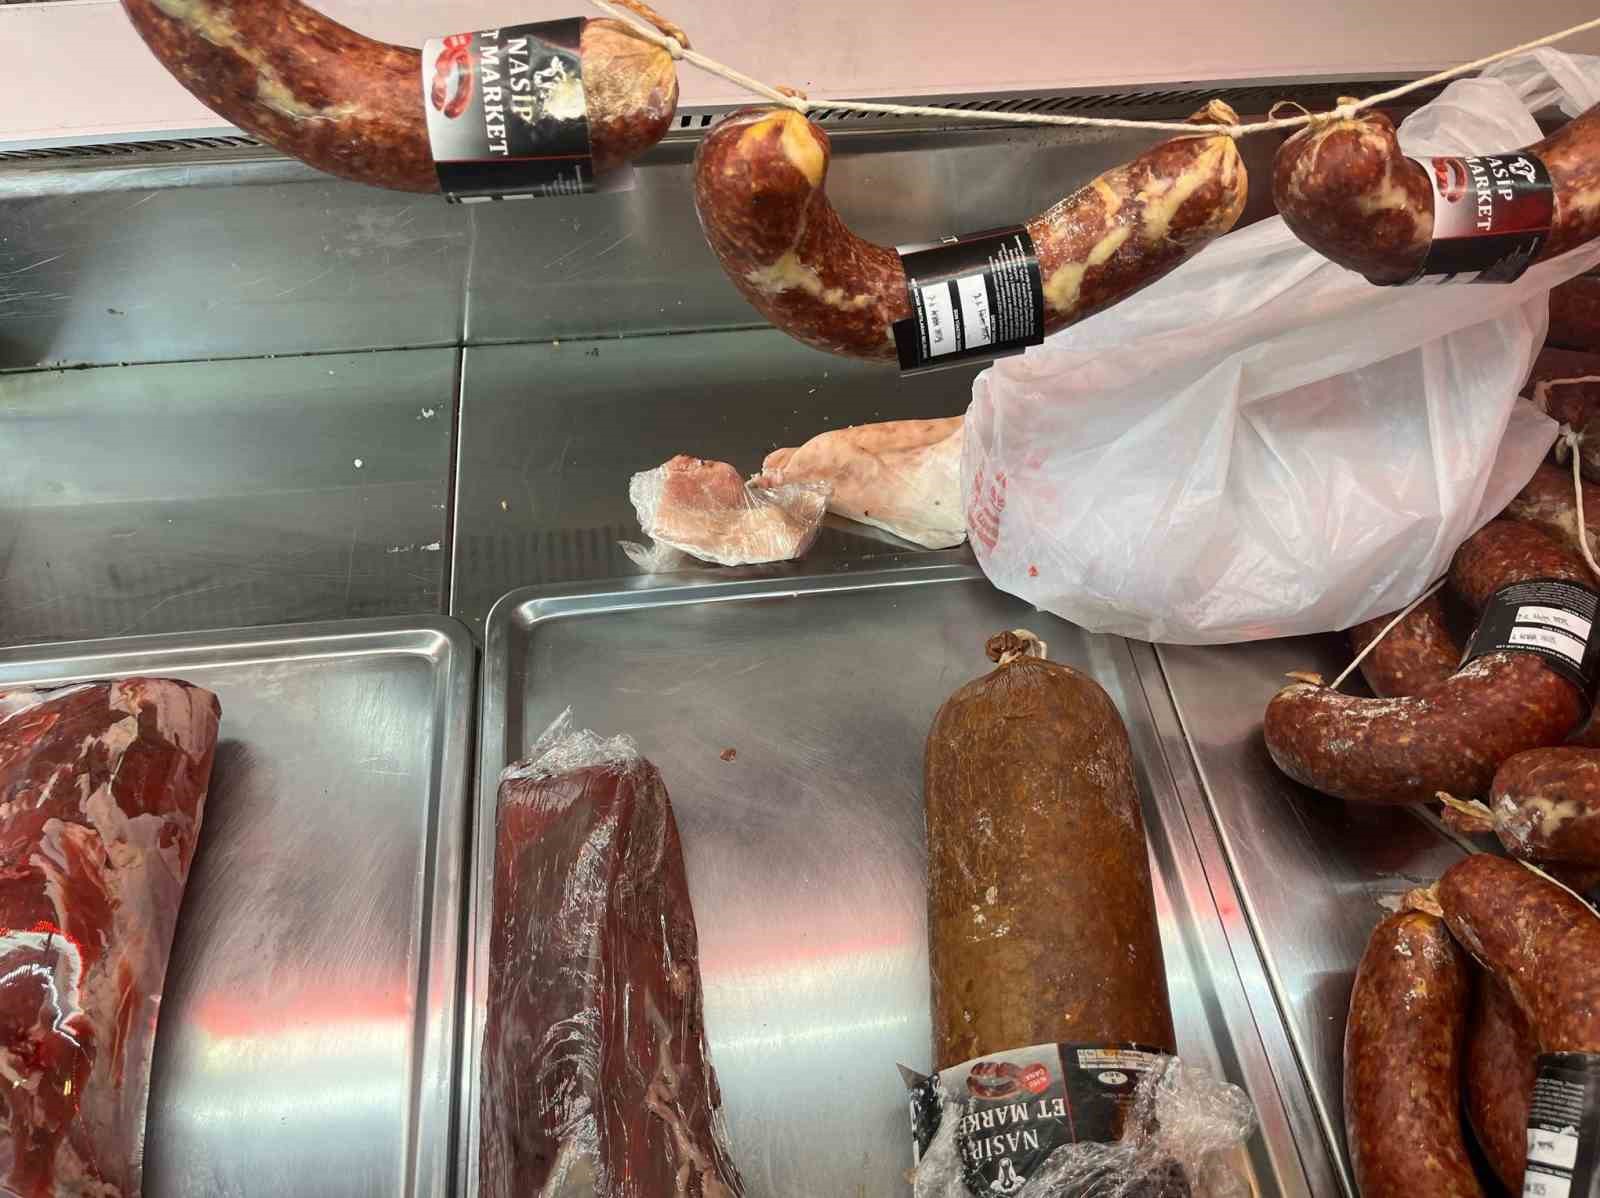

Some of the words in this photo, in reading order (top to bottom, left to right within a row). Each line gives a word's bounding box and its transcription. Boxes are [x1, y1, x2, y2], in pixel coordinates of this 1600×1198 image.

[480, 46, 509, 155] MARKET
[1488, 157, 1515, 201] ASİP
[959, 1103, 1029, 1135] MARKE
[1036, 1098, 1067, 1118] ET
